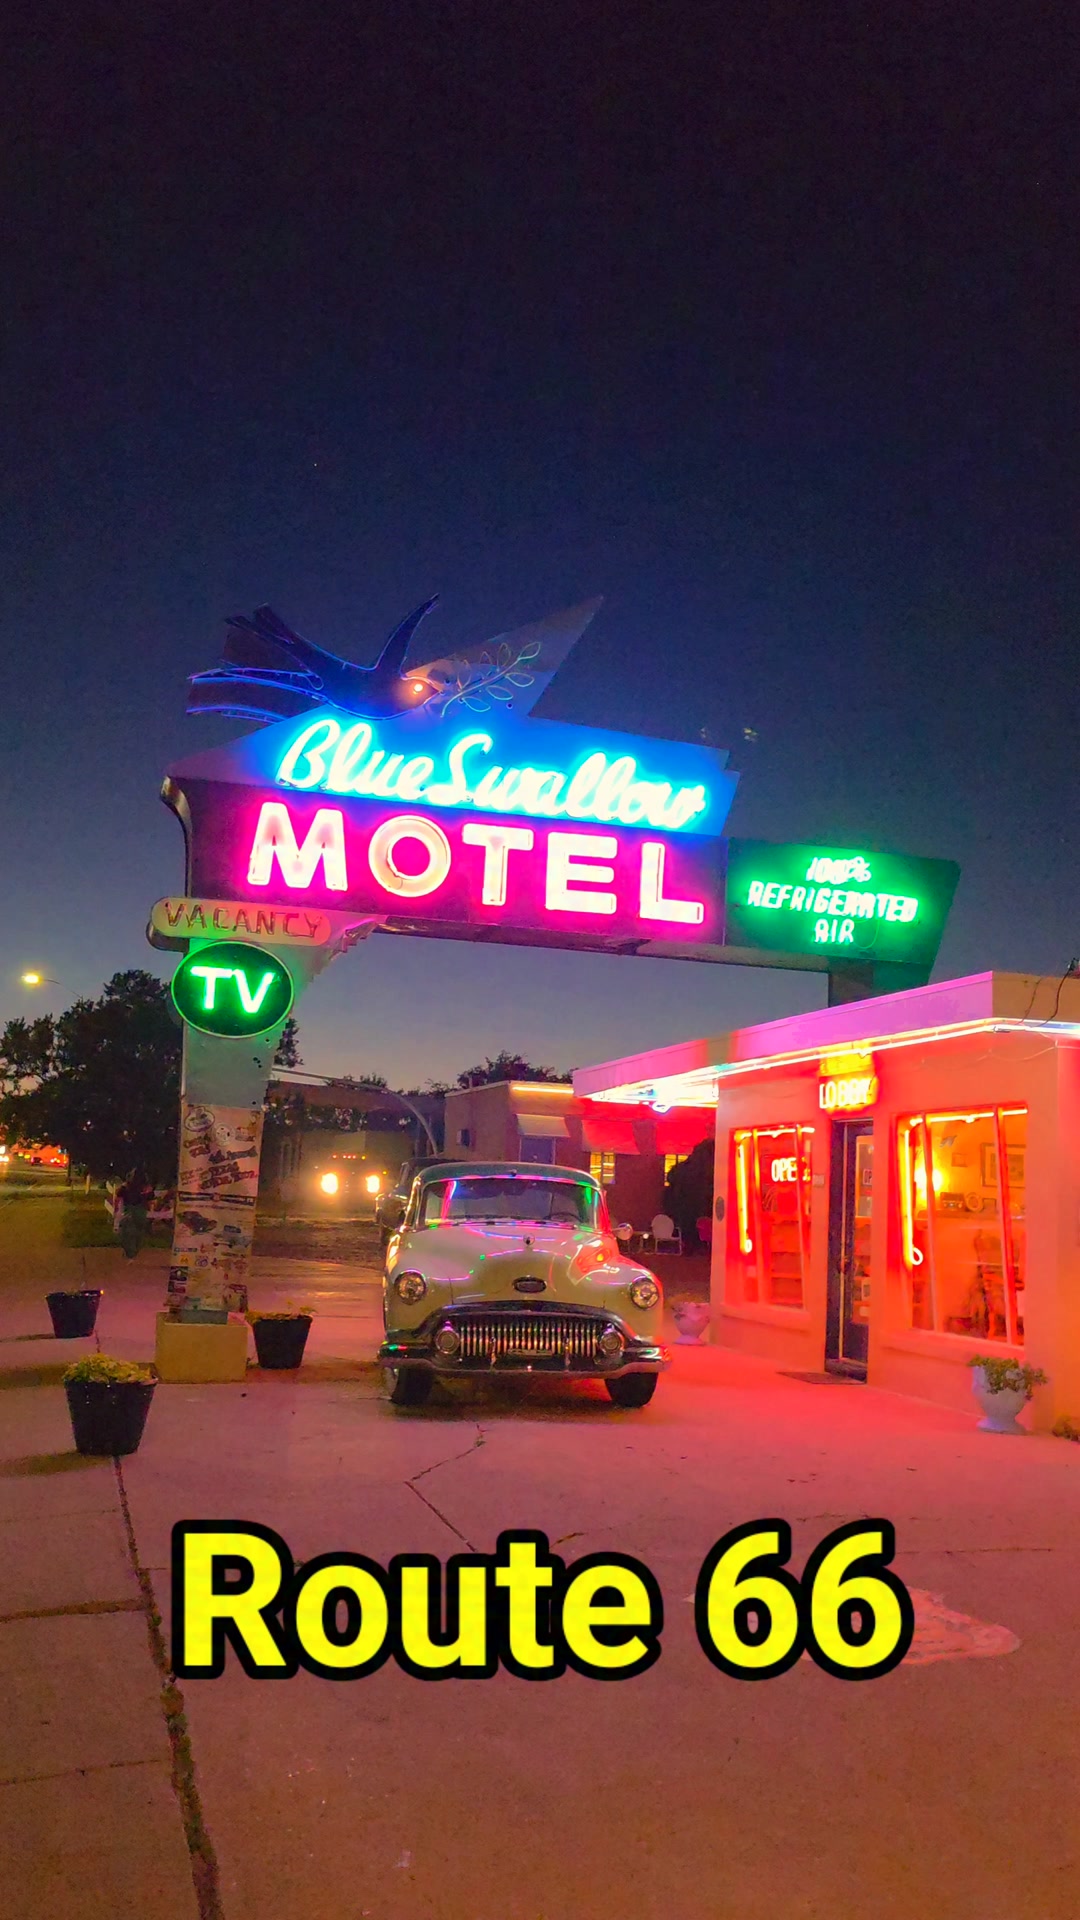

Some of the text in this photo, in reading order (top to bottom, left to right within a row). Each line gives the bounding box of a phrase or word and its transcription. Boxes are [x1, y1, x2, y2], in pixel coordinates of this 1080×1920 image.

[278, 719, 706, 829] Blue Swallow
[247, 801, 704, 925] MOTEL
[806, 856, 872, 884] 100%
[164, 901, 322, 938] VACANCY
[747, 880, 919, 923] REFRIGERATED
[814, 918, 855, 943] AIR
[190, 966, 276, 1013] TV
[819, 1078, 873, 1109] LOBBY
